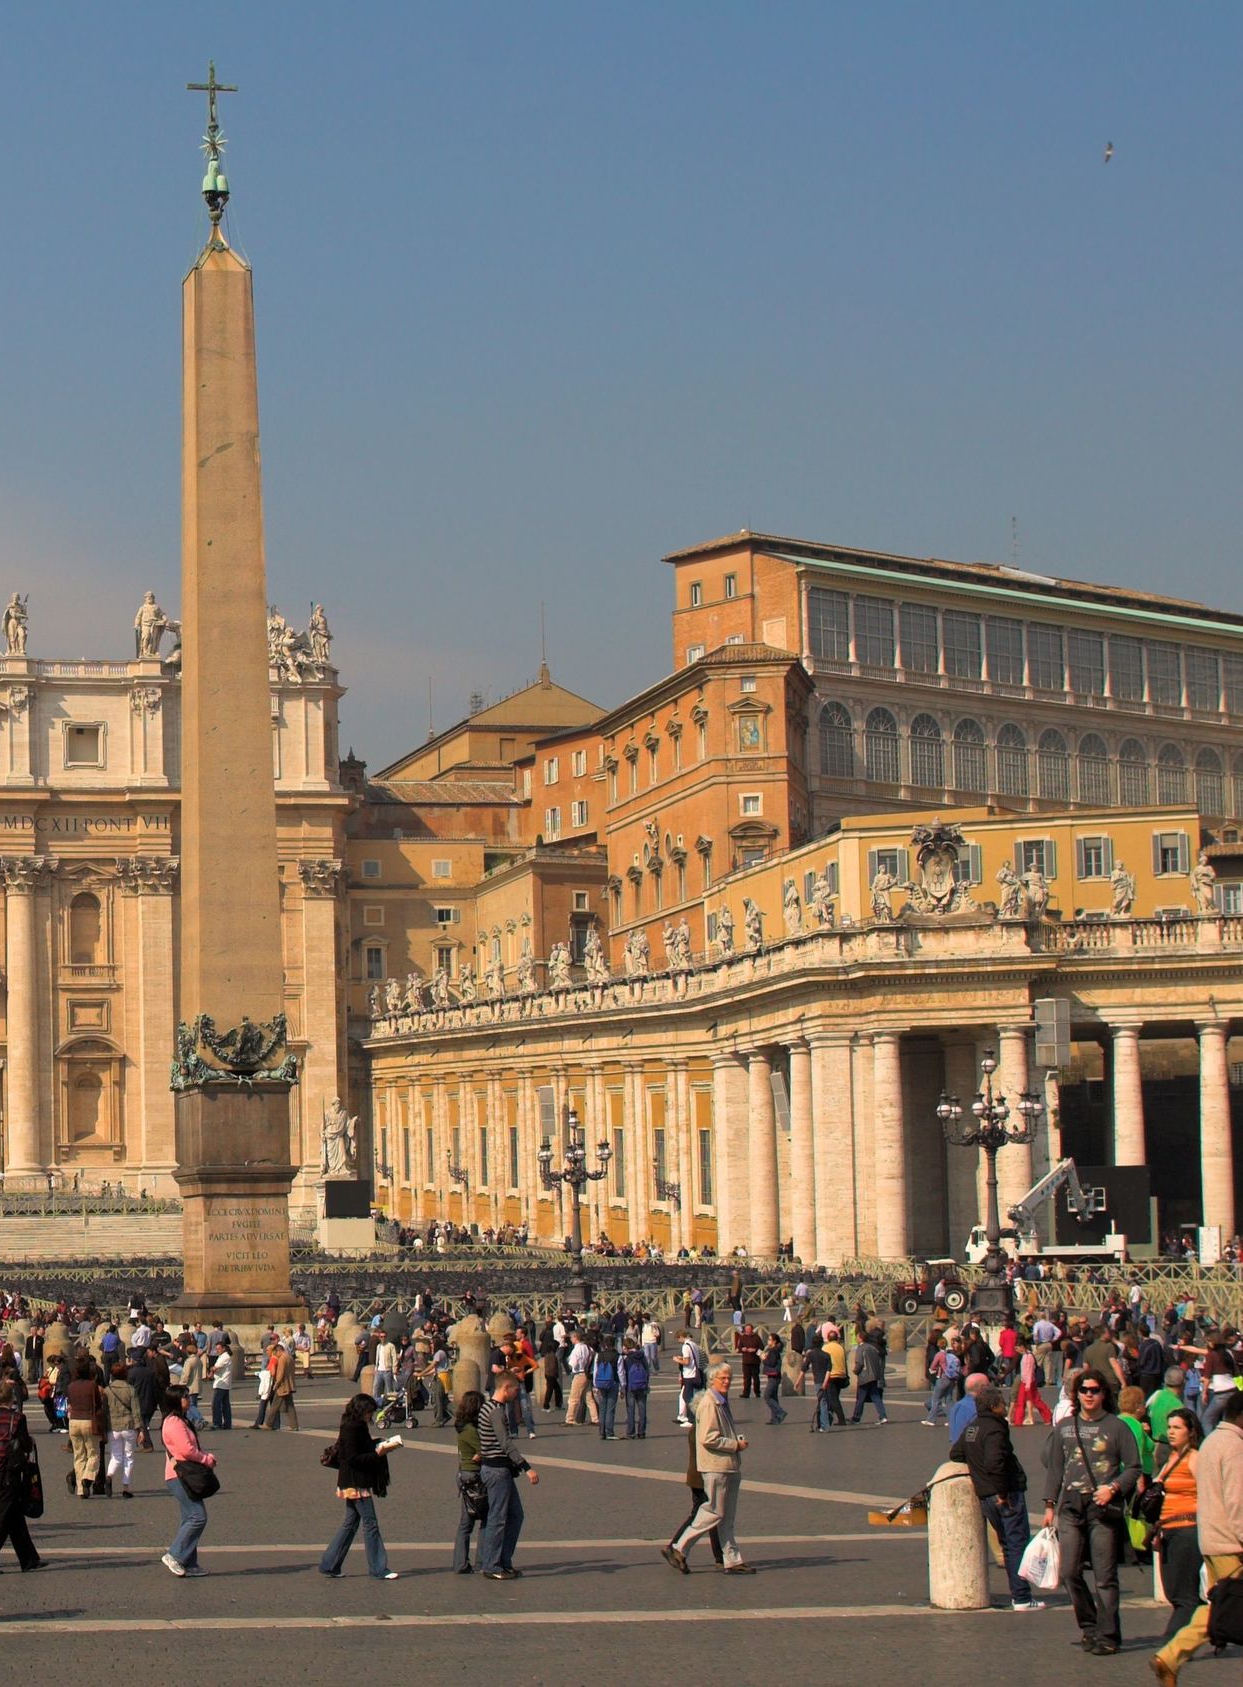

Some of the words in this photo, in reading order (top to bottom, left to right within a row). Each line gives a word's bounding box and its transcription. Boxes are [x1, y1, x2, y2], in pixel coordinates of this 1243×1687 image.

[4, 815, 79, 832] MDCXII
[83, 816, 134, 833] PONT
[142, 815, 168, 831] VII
[228, 1208, 251, 1216] CRVX
[251, 1208, 285, 1216] DOMINI
[209, 1233, 239, 1241] PARTES
[240, 1232, 285, 1241] ADVERSAE
[226, 1252, 249, 1260] VICIT
[252, 1251, 268, 1260] LEO
[218, 1264, 229, 1272] DE
